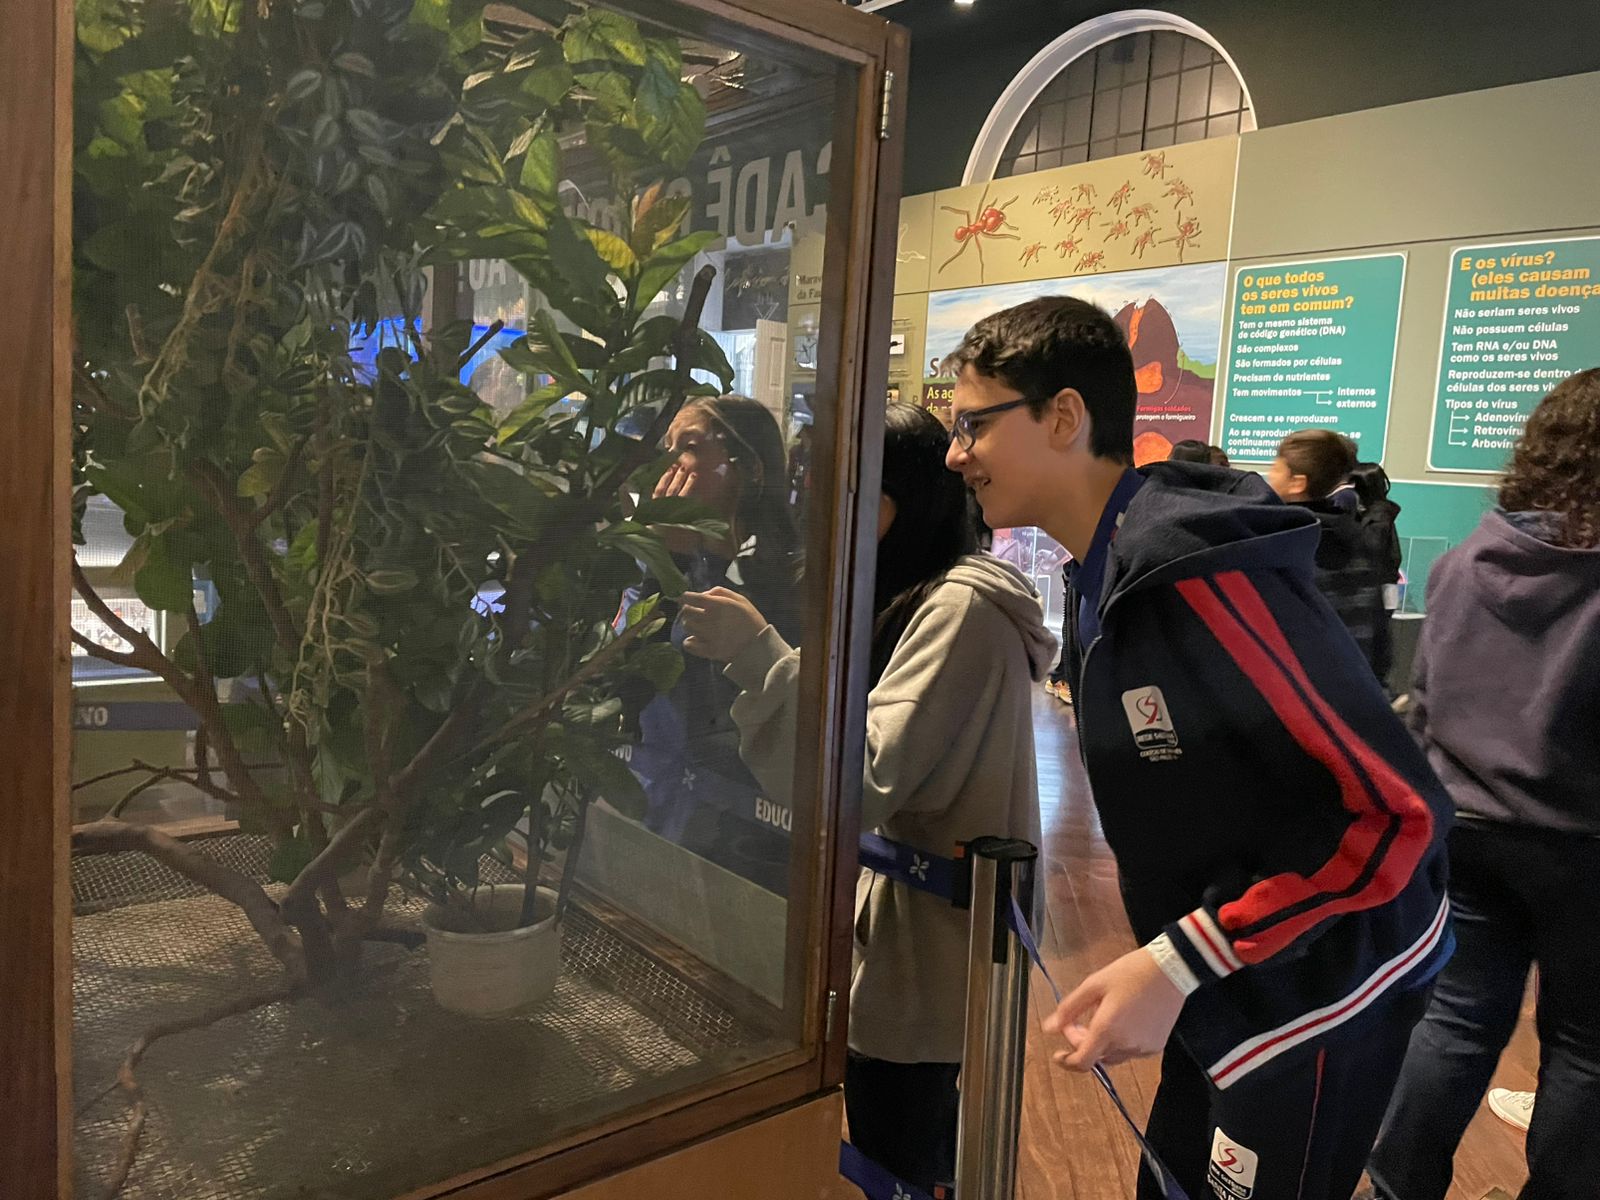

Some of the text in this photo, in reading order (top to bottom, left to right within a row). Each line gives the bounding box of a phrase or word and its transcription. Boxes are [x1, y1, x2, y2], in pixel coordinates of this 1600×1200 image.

[1460, 250, 1556, 271] E os vírus?
[1243, 271, 1325, 288] O que todos
[1471, 268, 1590, 288] (eles causam
[1242, 284, 1339, 302] os seres vivos
[1470, 285, 1530, 301] muitas
[1240, 296, 1354, 316] tem em comum?
[1454, 303, 1580, 319] Não seriam seres vivos
[1239, 320, 1256, 330] Tem
[1264, 319, 1296, 329] mesmo
[1297, 317, 1333, 327] sistema
[1452, 321, 1569, 337] Não possuem células
[1238, 325, 1346, 340] de código genético (DNA)
[1236, 343, 1299, 355] São complexos
[1451, 339, 1558, 352] Tem RNA e/ou DNA
[1235, 356, 1342, 369] São formados por células
[1450, 351, 1559, 363] como os seres vivos
[1233, 372, 1331, 383] Precisam de nutrientes
[1448, 368, 1531, 381] Reproduzem-se
[1533, 368, 1571, 379] dentro
[927, 386, 954, 402] As ag
[1232, 388, 1250, 397] Tem
[1250, 388, 1302, 397] movimentos
[1446, 382, 1484, 393] células
[1486, 382, 1507, 392] dos
[1508, 383, 1540, 393] seres
[1336, 399, 1377, 408] externos
[1445, 398, 1518, 411] Tipos de vírus
[1229, 413, 1265, 423] Crescem
[1286, 414, 1338, 424] reproduzem
[1474, 412, 1529, 423] Adenovíru
[1228, 427, 1239, 437] Ao
[1241, 429, 1250, 437] se
[1473, 425, 1523, 436] Retrovíru
[1227, 438, 1281, 448] continuamen
[1471, 438, 1514, 449] Arbovír
[1227, 447, 1278, 457] do ambiente
